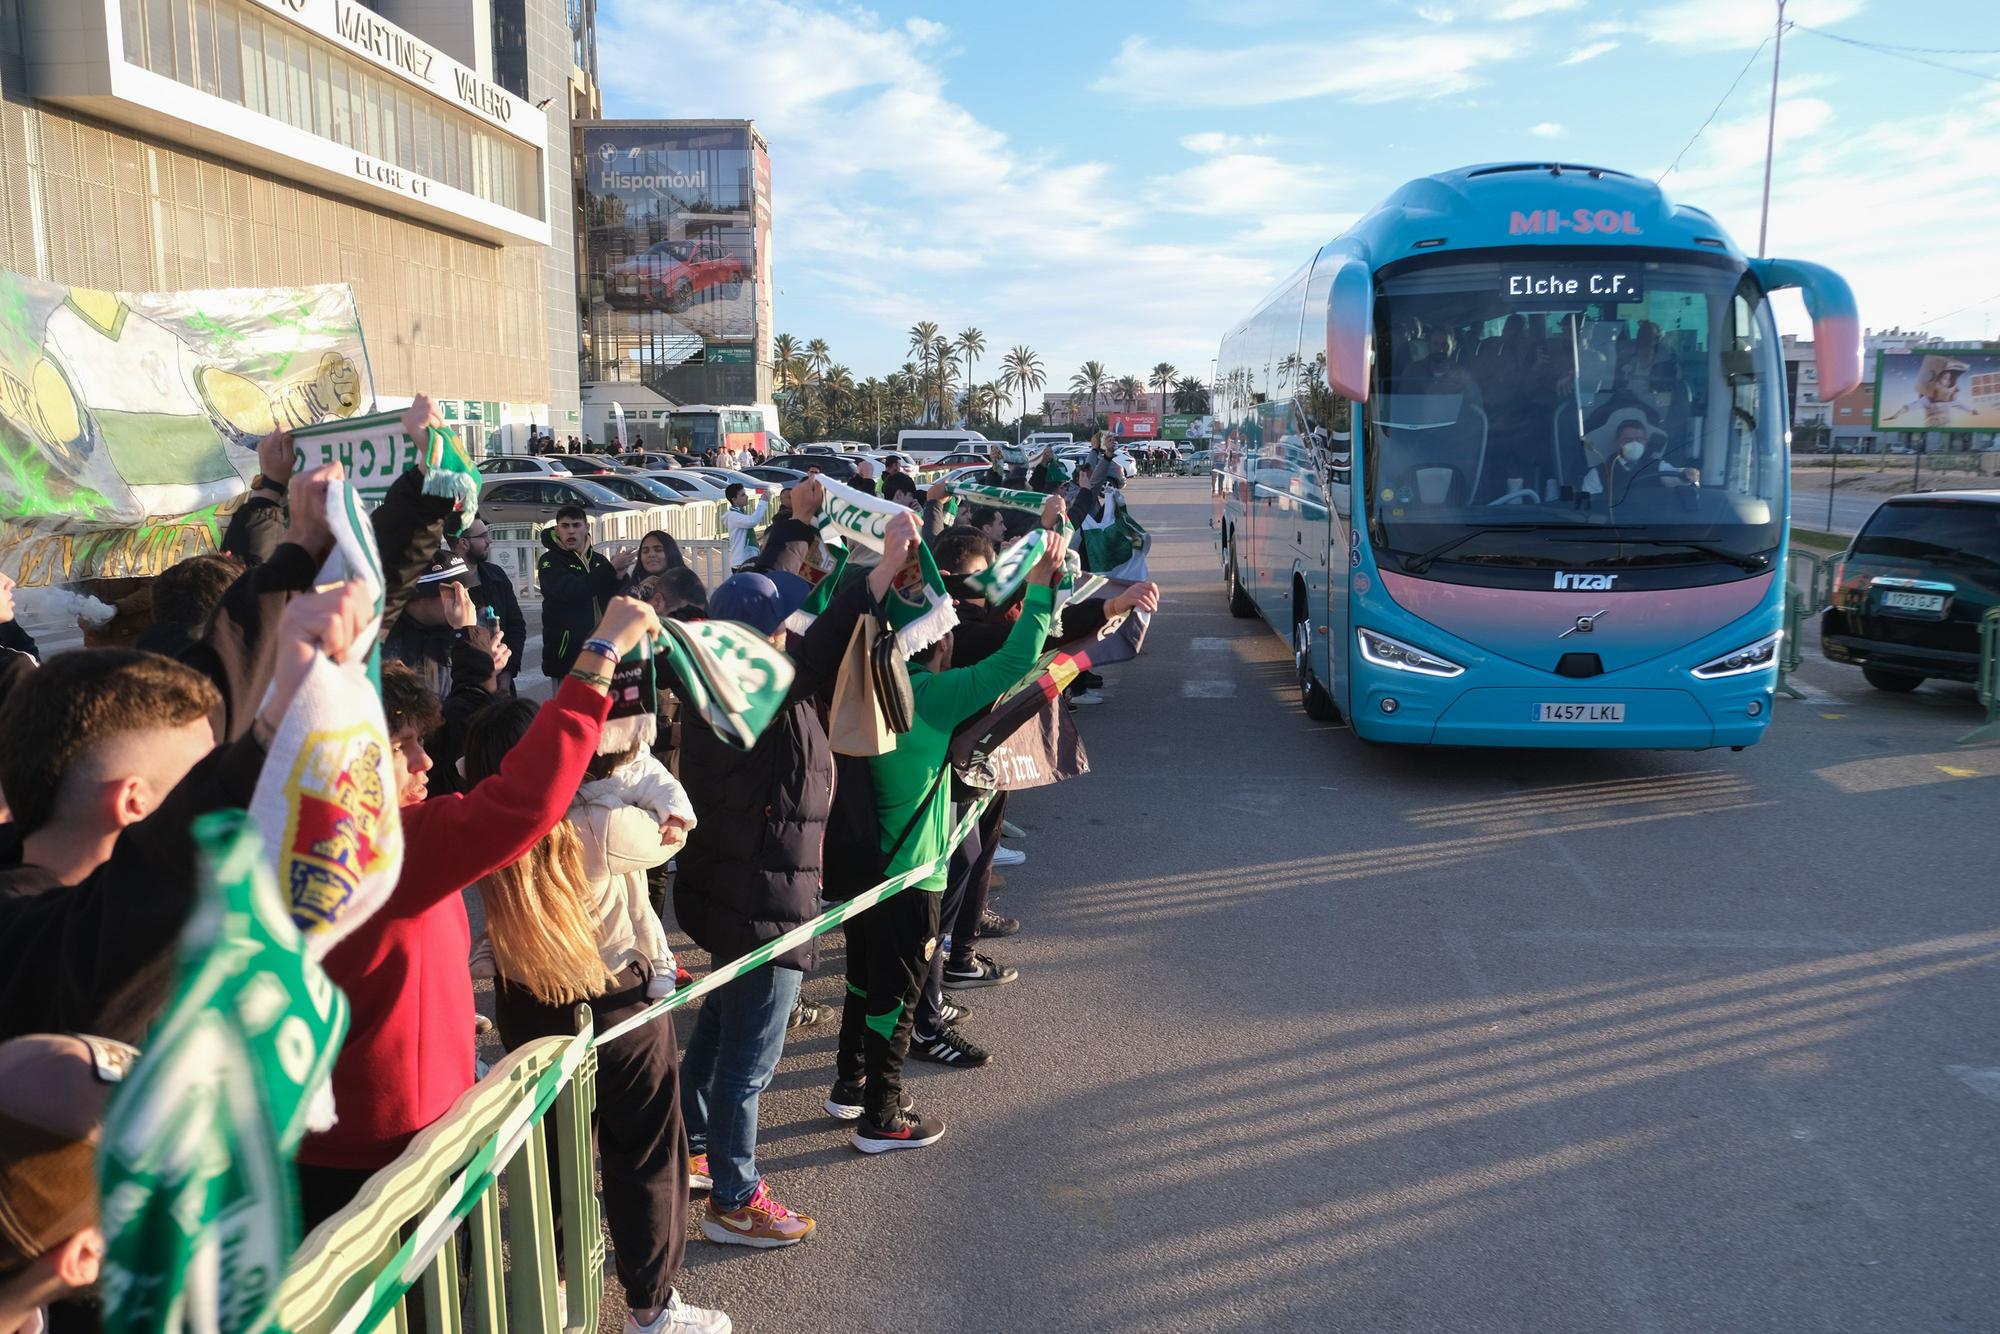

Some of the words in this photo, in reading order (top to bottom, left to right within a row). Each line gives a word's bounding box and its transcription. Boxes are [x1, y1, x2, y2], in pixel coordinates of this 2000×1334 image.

[335, 0, 436, 84] MARTINEZ
[454, 68, 512, 123] VALERO
[355, 157, 405, 190] ELCHE
[412, 179, 431, 197] CF
[601, 170, 706, 192] Hispamóvil
[1509, 209, 1643, 236] MI-SOL
[1509, 274, 1579, 295] Elche
[1589, 274, 1635, 295] C.F.
[1553, 570, 1618, 590] Irizar
[1546, 705, 1585, 719] 1457
[1590, 706, 1621, 720] LKL
